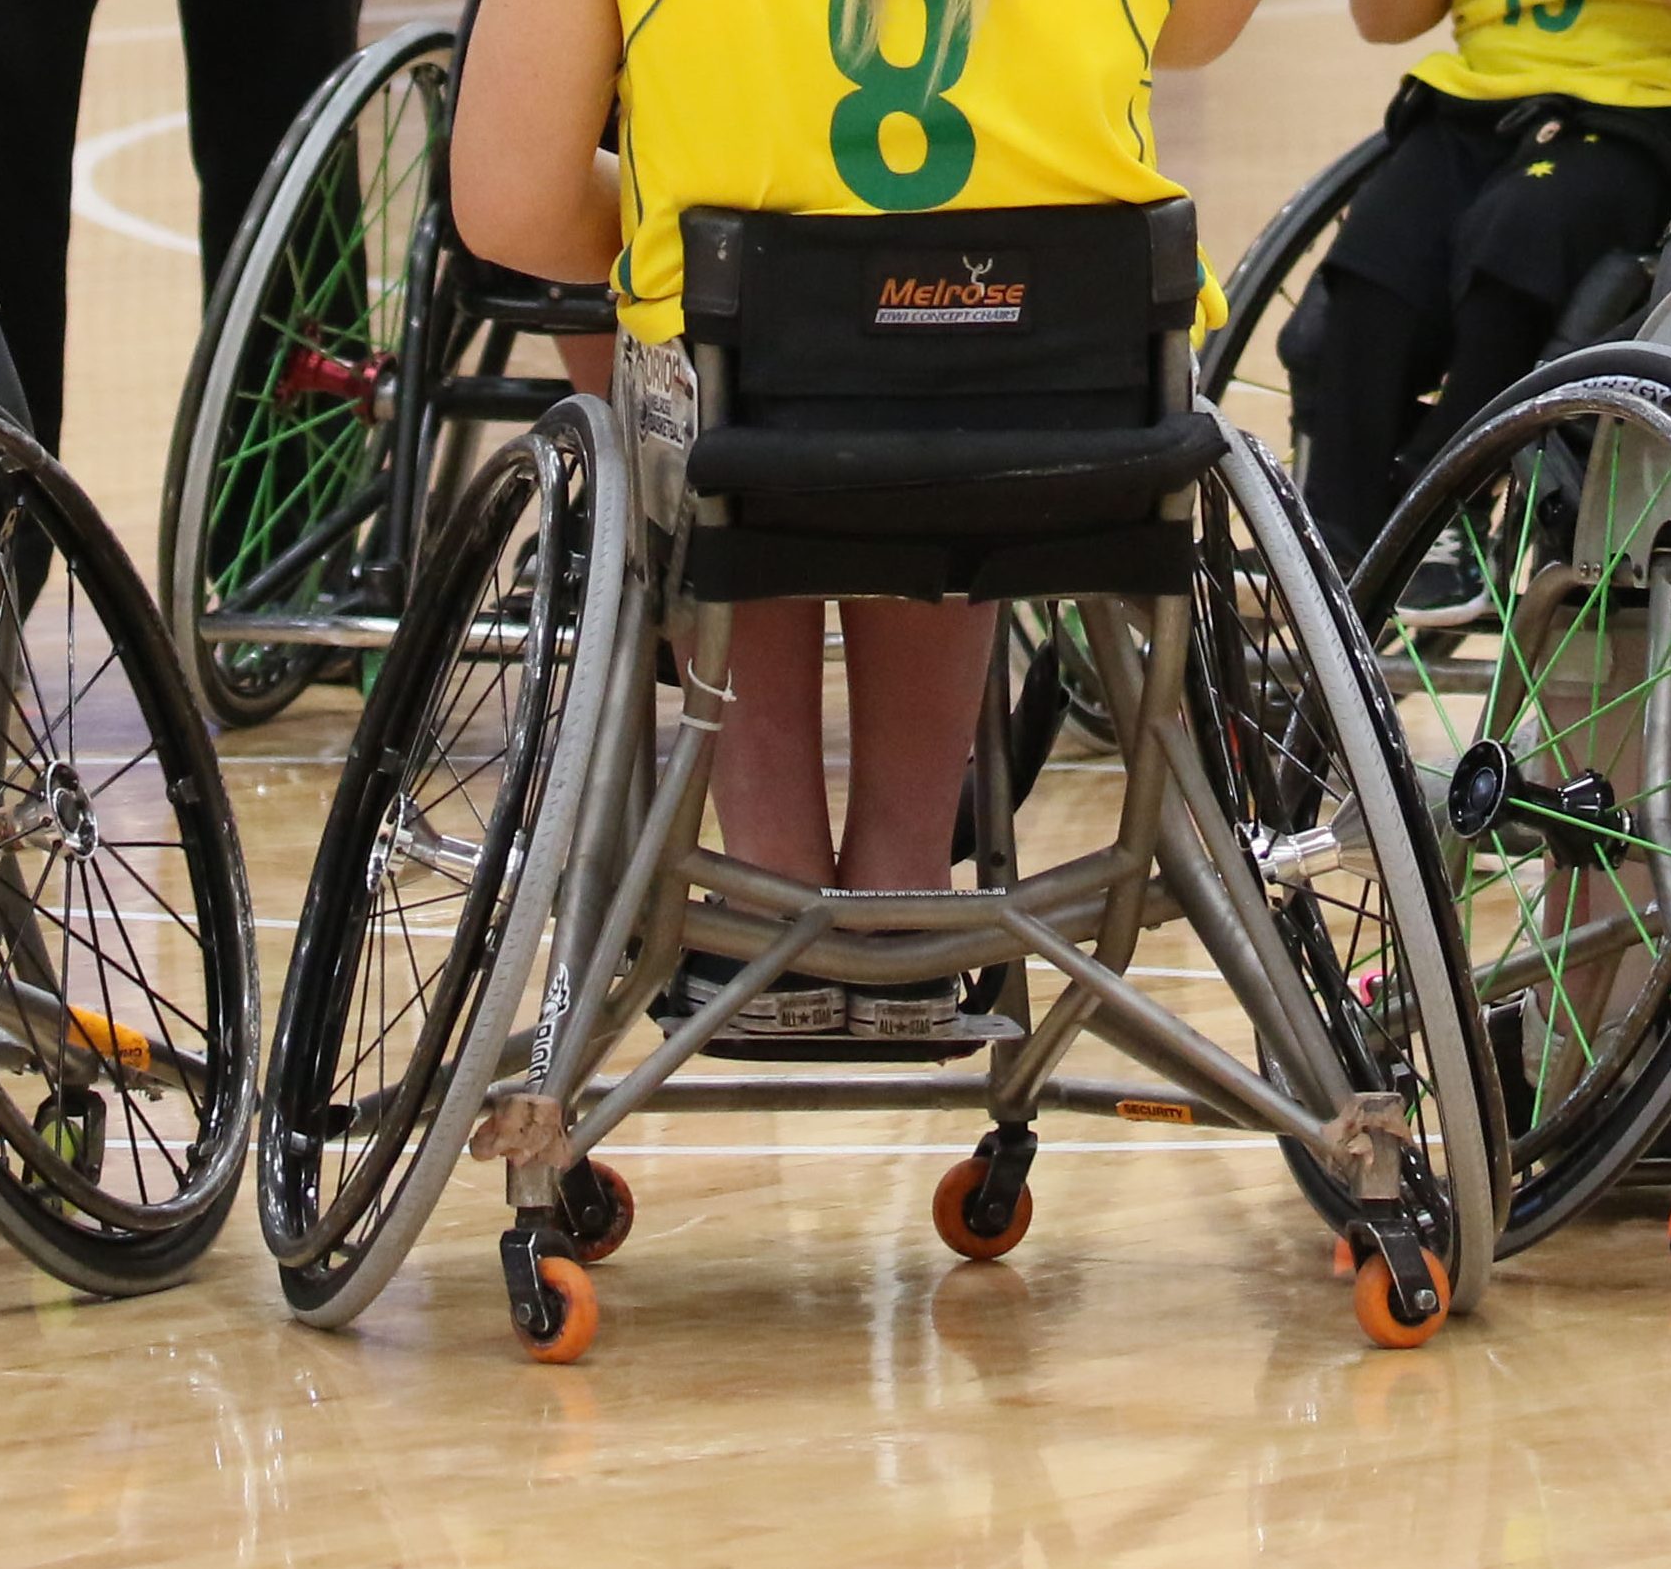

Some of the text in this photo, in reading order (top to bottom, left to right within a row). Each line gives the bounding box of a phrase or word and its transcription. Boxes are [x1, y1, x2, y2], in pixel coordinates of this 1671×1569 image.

[879, 278, 1026, 306] Melrose
[880, 309, 1017, 322] KIWI CONCEPT CHAIRS
[880, 1019, 893, 1035] ALL
[1124, 1103, 1183, 1119] SECURITY
